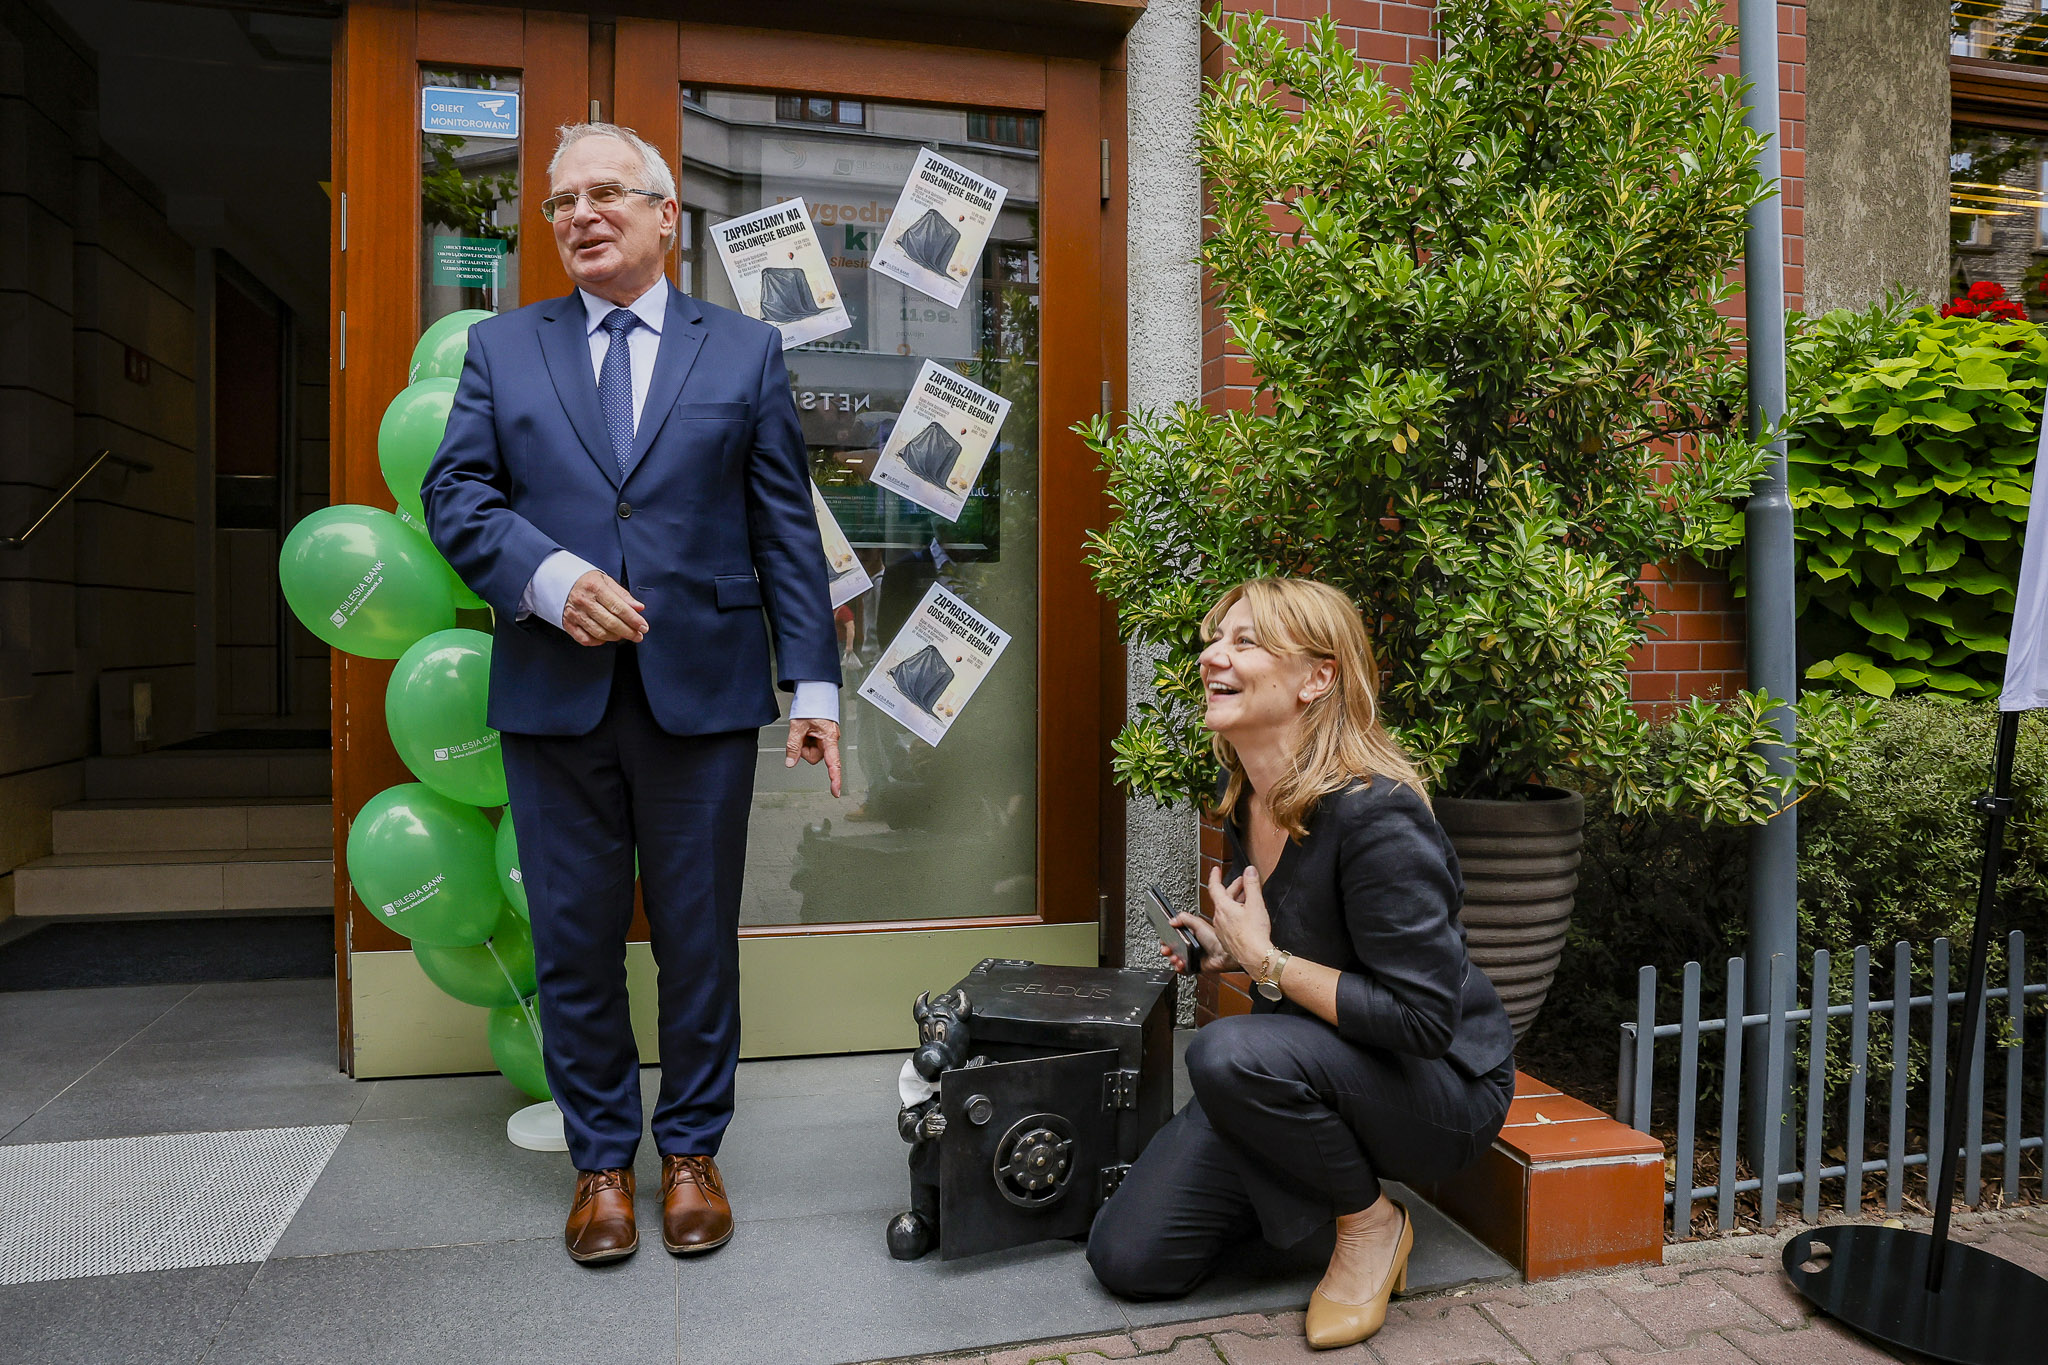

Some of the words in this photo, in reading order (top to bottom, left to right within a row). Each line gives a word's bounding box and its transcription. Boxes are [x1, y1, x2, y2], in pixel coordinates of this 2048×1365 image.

[430, 117, 511, 130] MONITOROWANY
[431, 103, 465, 114] OBIEKT
[920, 170, 965, 198] ODSŁONIĘCIE
[965, 191, 993, 212] BEBOKA
[925, 157, 984, 194] ZAPRASZAMY
[983, 187, 998, 201] NA
[723, 212, 785, 242] ZAPRASZAMY
[786, 208, 801, 222] NA
[728, 230, 776, 253] ODSŁONIĘCIE
[775, 221, 806, 239] BEBOKA
[924, 382, 968, 411] ODSŁONIĘCIE
[967, 404, 995, 425] BEBOKA
[928, 370, 987, 406] ZAPRASZAMY
[986, 399, 1000, 414] NA
[340, 582, 368, 612] SILESIA
[363, 559, 386, 584] BANK
[349, 575, 384, 616] www.silesiabank.pl
[926, 605, 969, 639] ODSŁONIĘCIE
[966, 633, 993, 657] BEBOKA
[933, 593, 989, 637] ZAPRASZAMY
[986, 631, 1001, 647] NA
[449, 738, 482, 754] SILESIA
[482, 730, 500, 743] BAN
[393, 889, 424, 908] SILESIA
[421, 873, 446, 892] BANK
[1000, 982, 1112, 999] GELDUS
